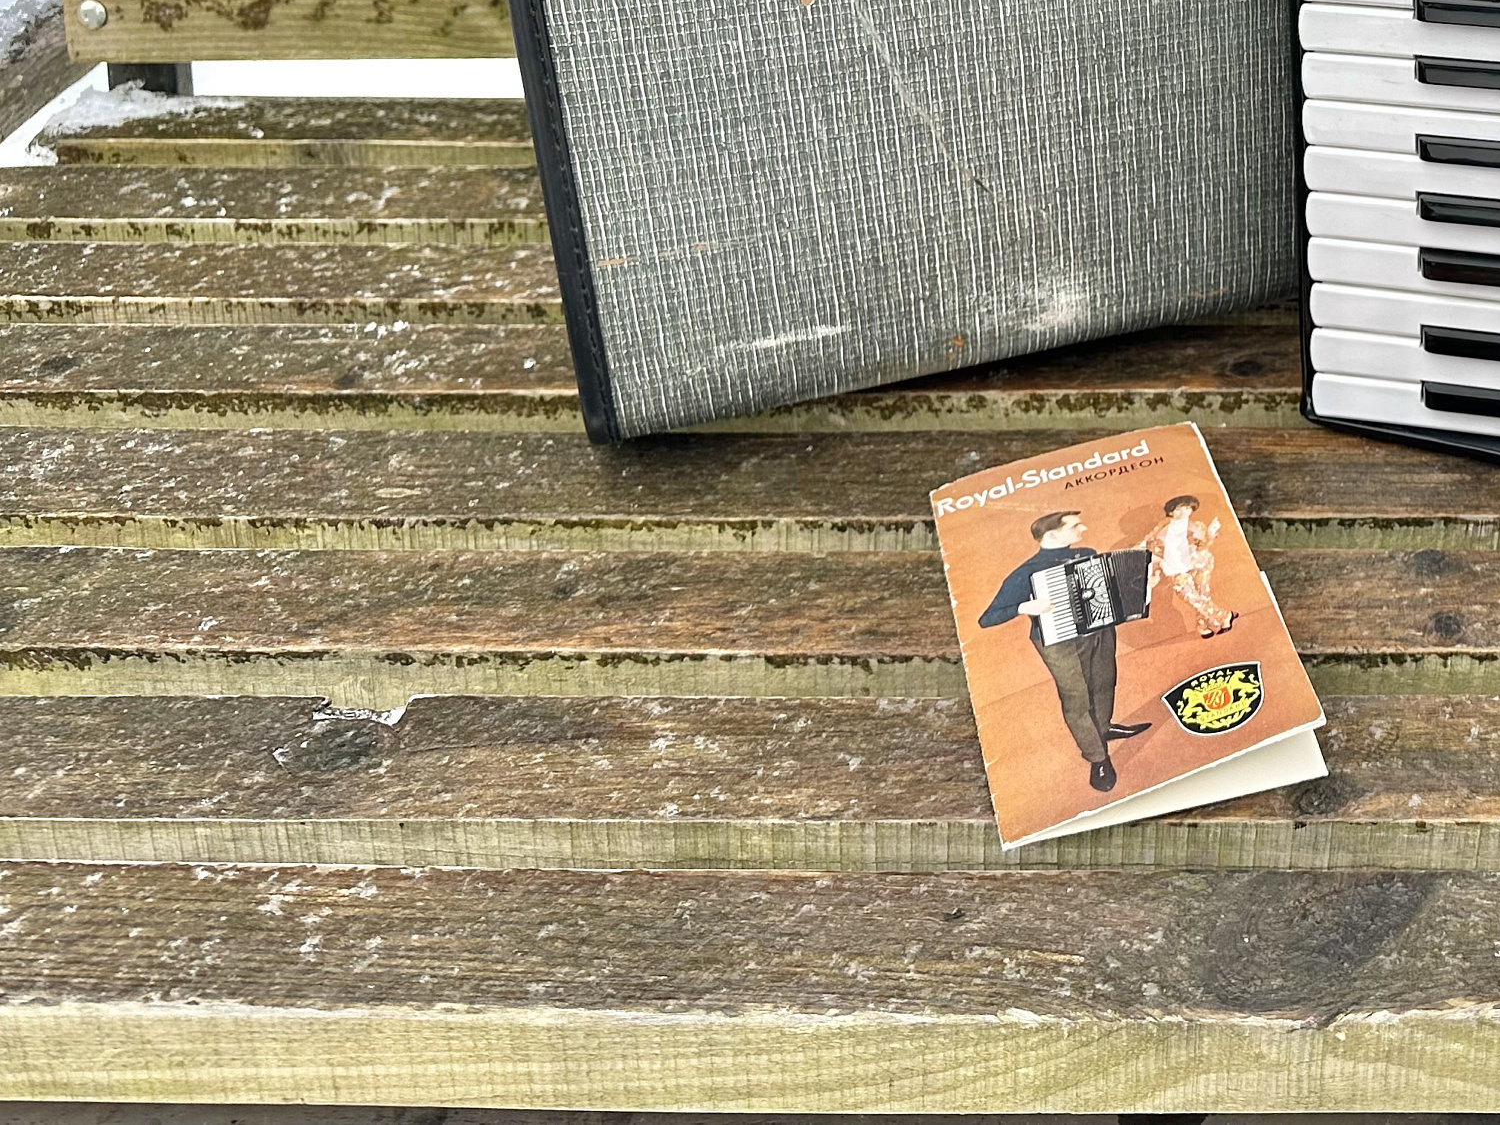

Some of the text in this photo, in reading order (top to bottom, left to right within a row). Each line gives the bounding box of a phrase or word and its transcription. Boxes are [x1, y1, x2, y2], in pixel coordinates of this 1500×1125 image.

[936, 439, 1150, 517] Royal-Standard
[1064, 456, 1165, 490] АККОРДЕОН
[1190, 669, 1232, 687] ROYAL
